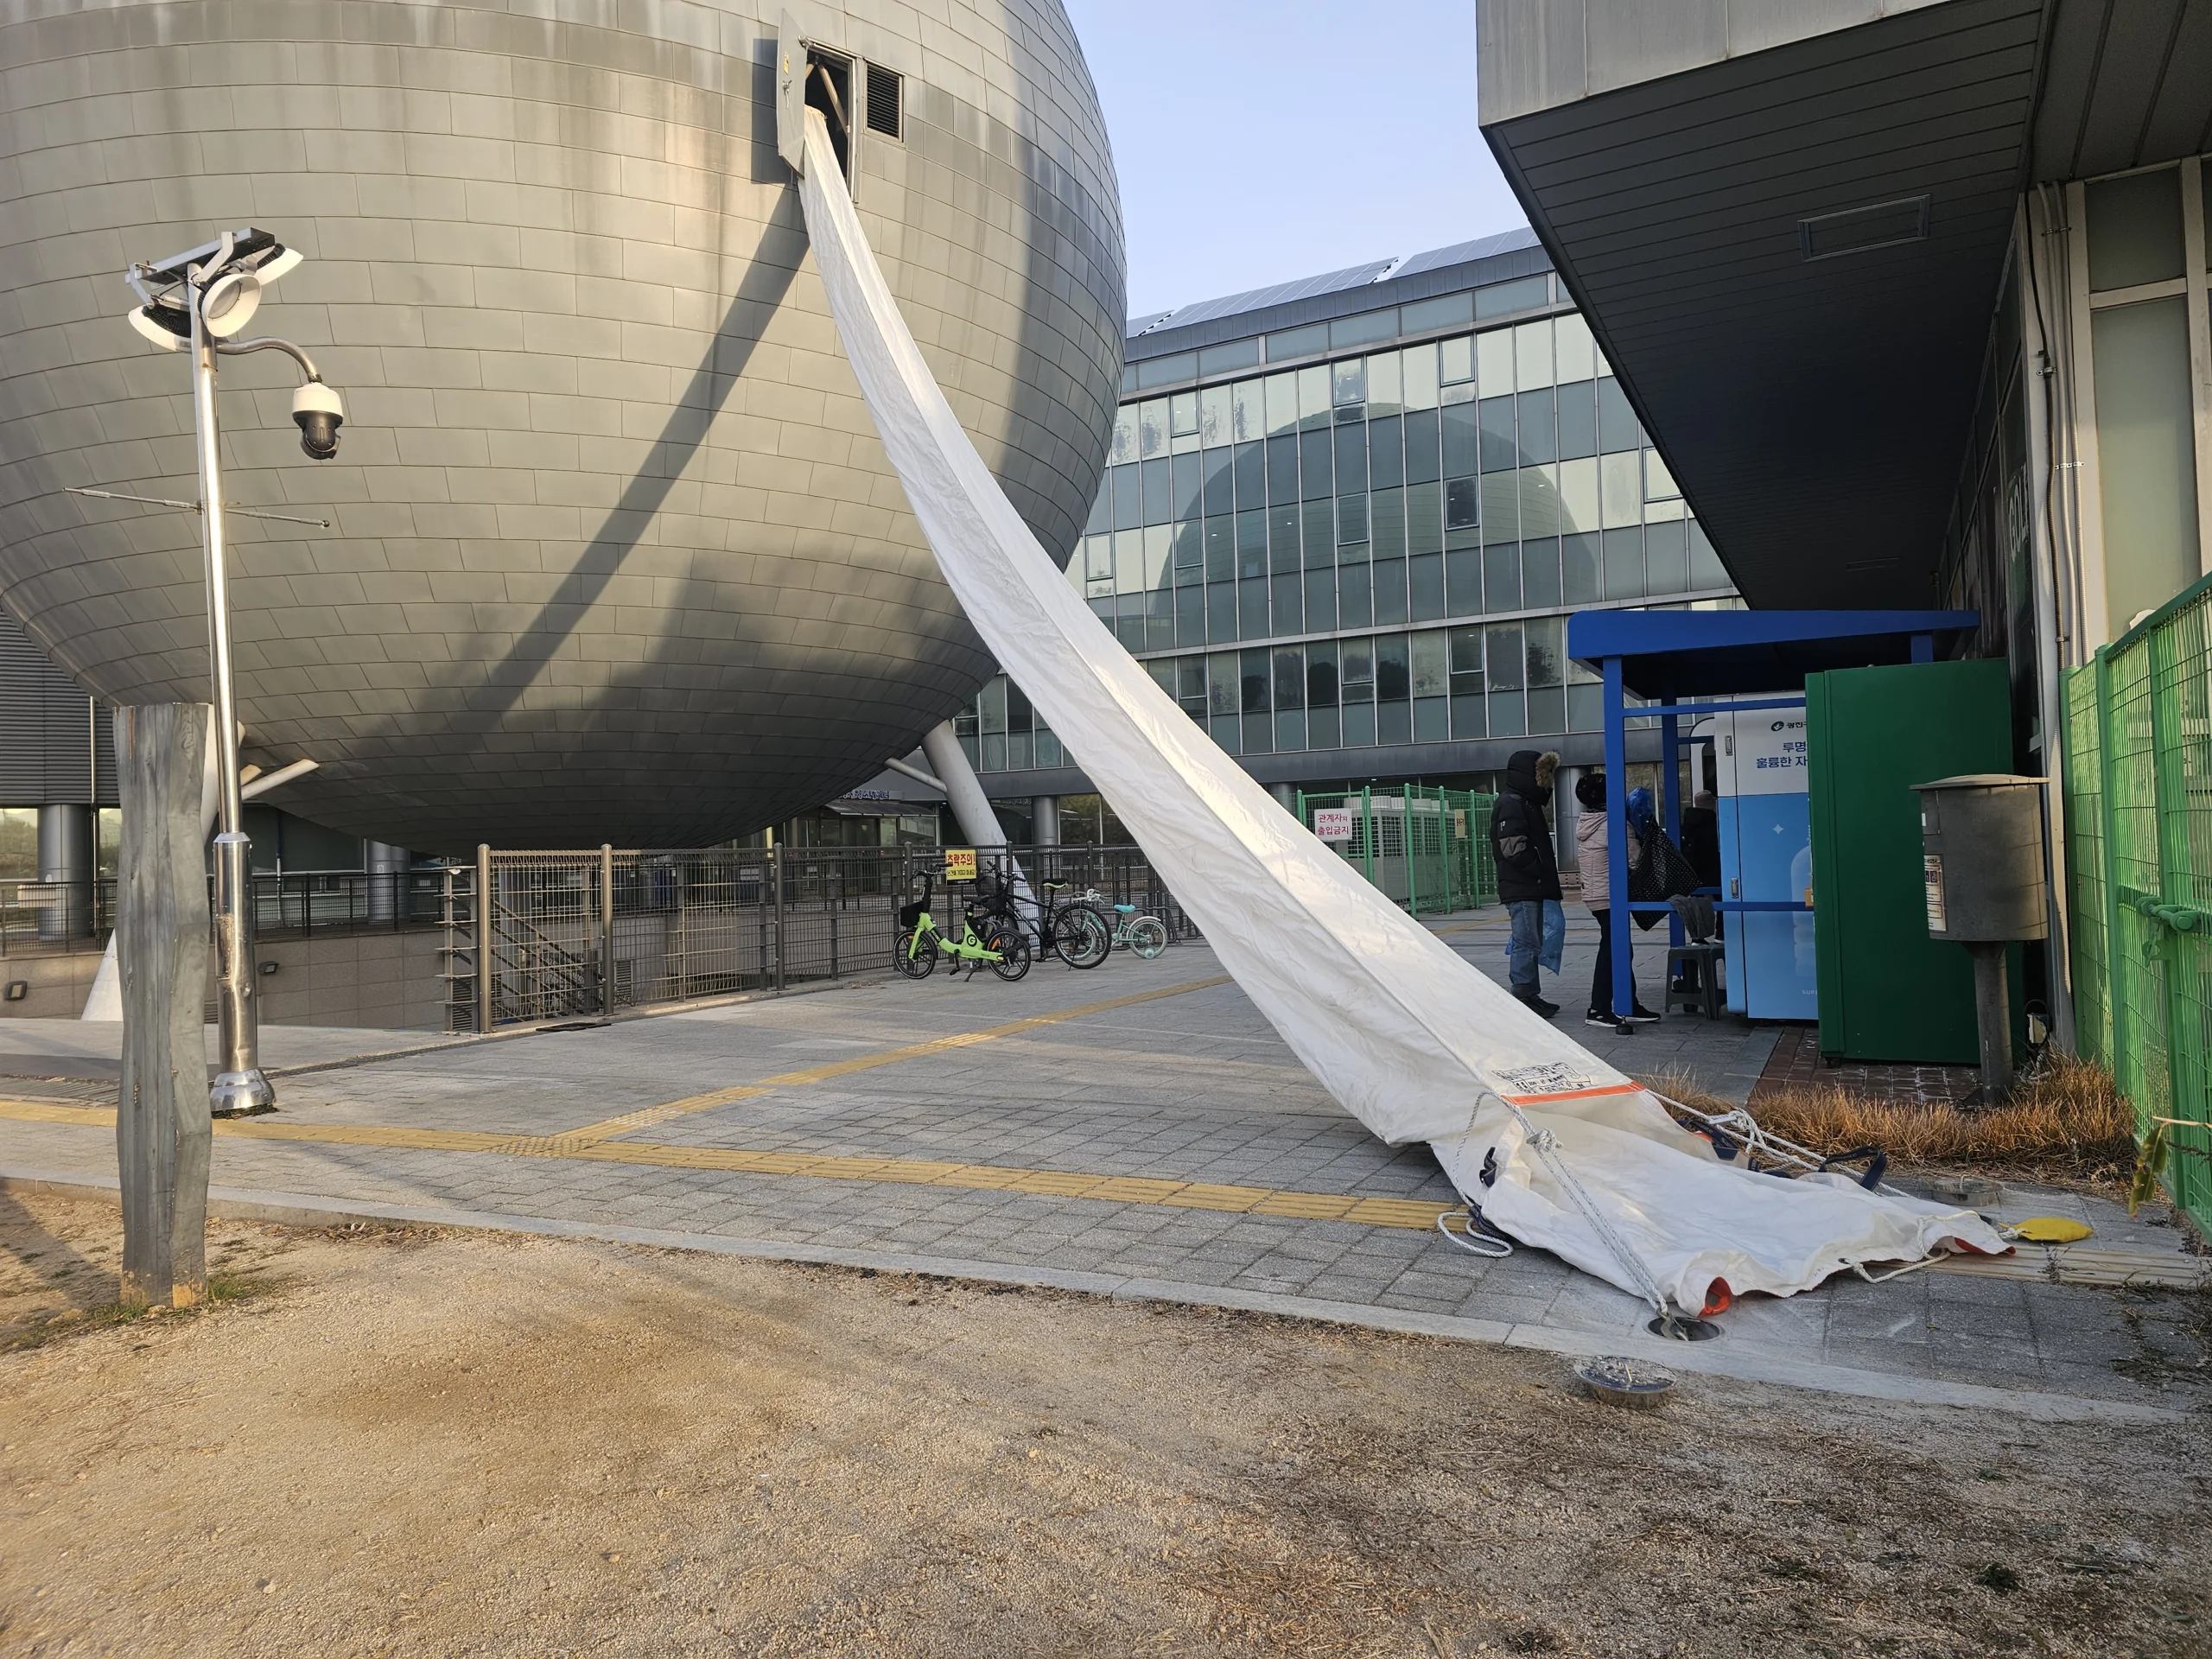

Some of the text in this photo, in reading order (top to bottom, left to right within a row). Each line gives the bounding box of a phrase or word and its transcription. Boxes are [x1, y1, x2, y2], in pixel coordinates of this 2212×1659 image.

[1756, 757, 1792, 768] 훌륭한
[1319, 813, 1348, 823] 관계자외
[1318, 825, 1349, 836] 출입금지
